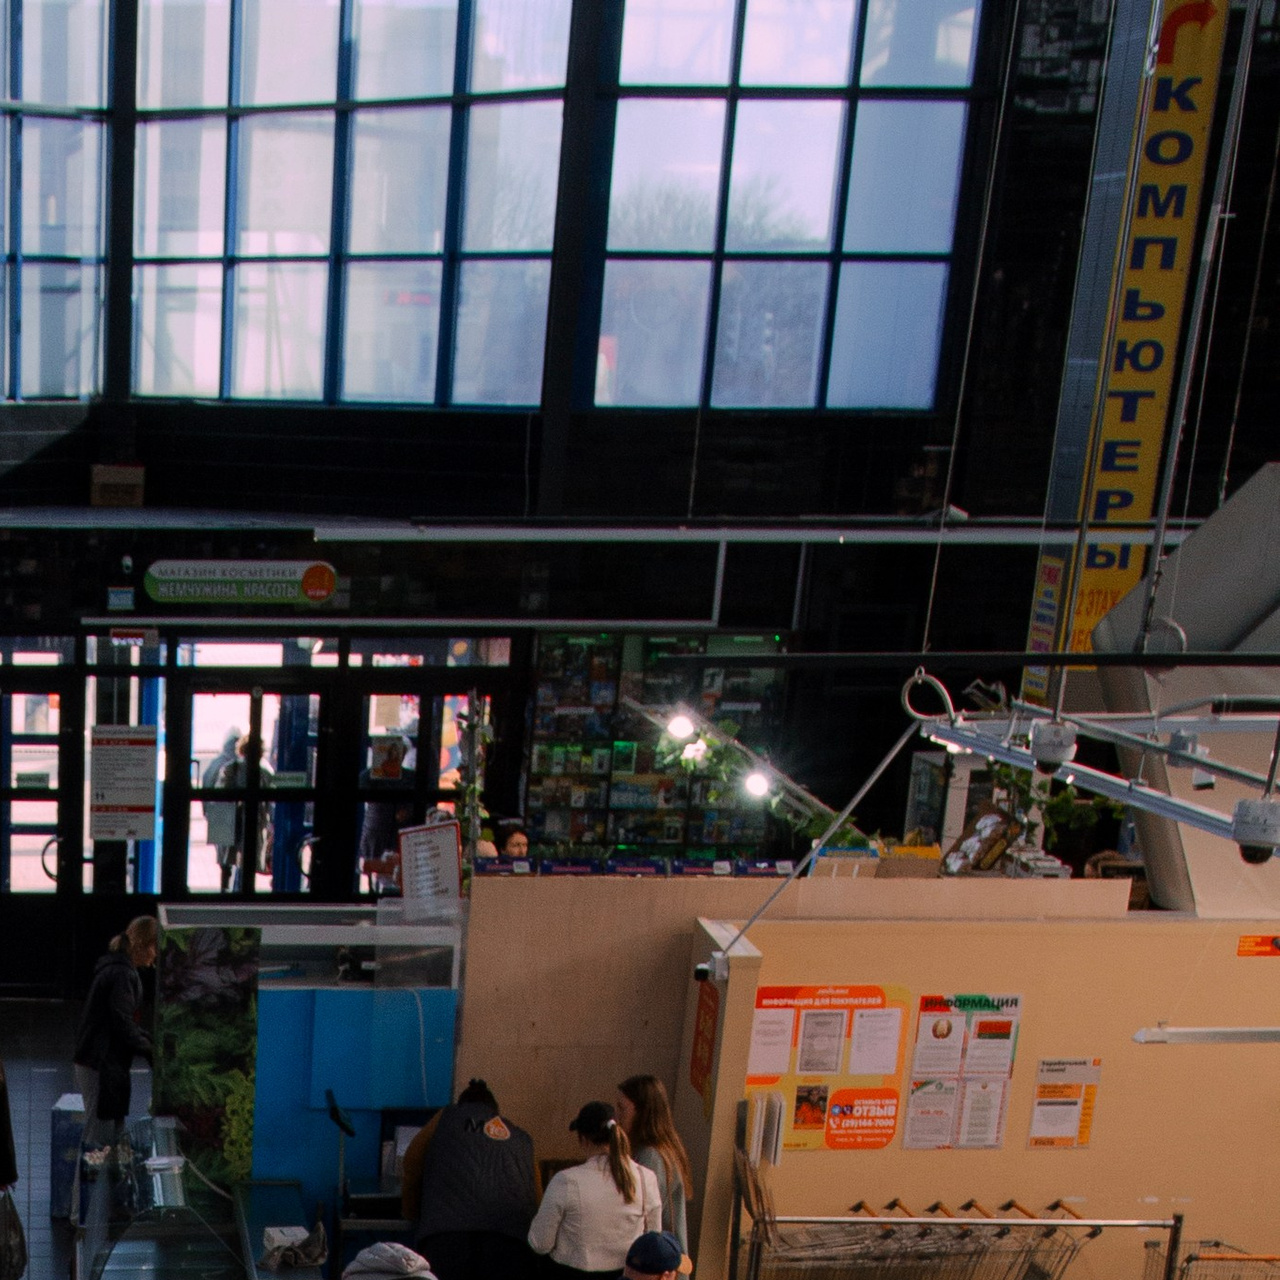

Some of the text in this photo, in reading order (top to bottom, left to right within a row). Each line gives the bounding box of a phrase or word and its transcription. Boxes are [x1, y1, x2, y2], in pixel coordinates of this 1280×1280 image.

[1084, 76, 1202, 570] КОМПЬЮТЕРЫ
[158, 582, 239, 597] ЖЕМЧУЖИНА
[244, 582, 299, 597] КРАСОТЫ
[924, 997, 1019, 1010] ИНФОРМАЦИЯ
[853, 1105, 896, 1117] ОТЗЫВ
